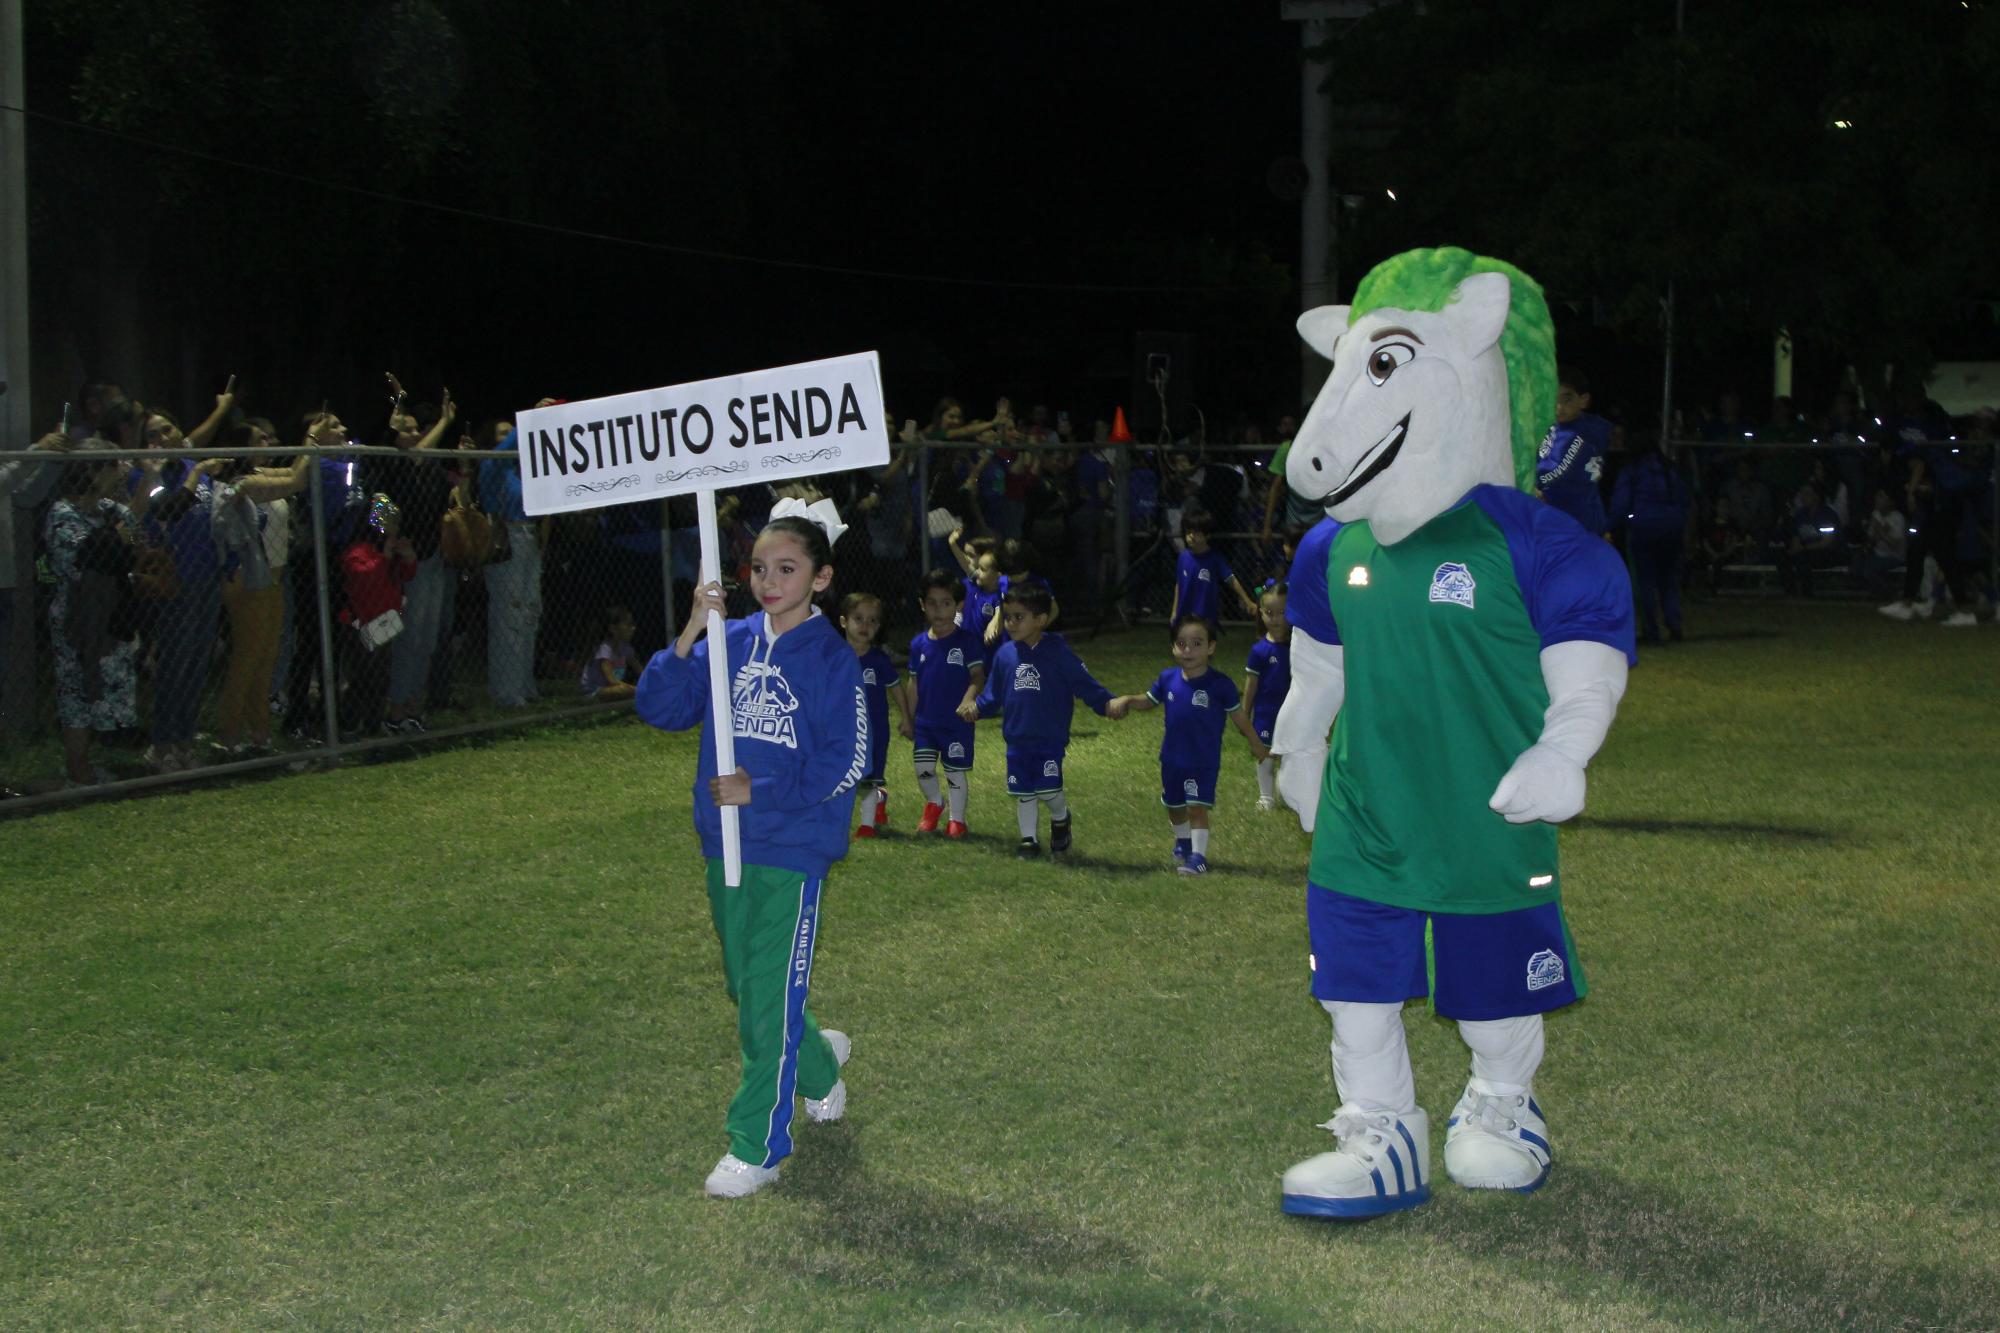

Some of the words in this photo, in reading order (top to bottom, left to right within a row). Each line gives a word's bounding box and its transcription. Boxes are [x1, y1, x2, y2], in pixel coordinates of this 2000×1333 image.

[528, 403, 714, 478] INSTITUTO
[727, 382, 867, 448] SENDA
[1540, 435, 1584, 484] KNOWMADS
[733, 714, 797, 748] ENDA
[826, 686, 868, 799] KNOWMA
